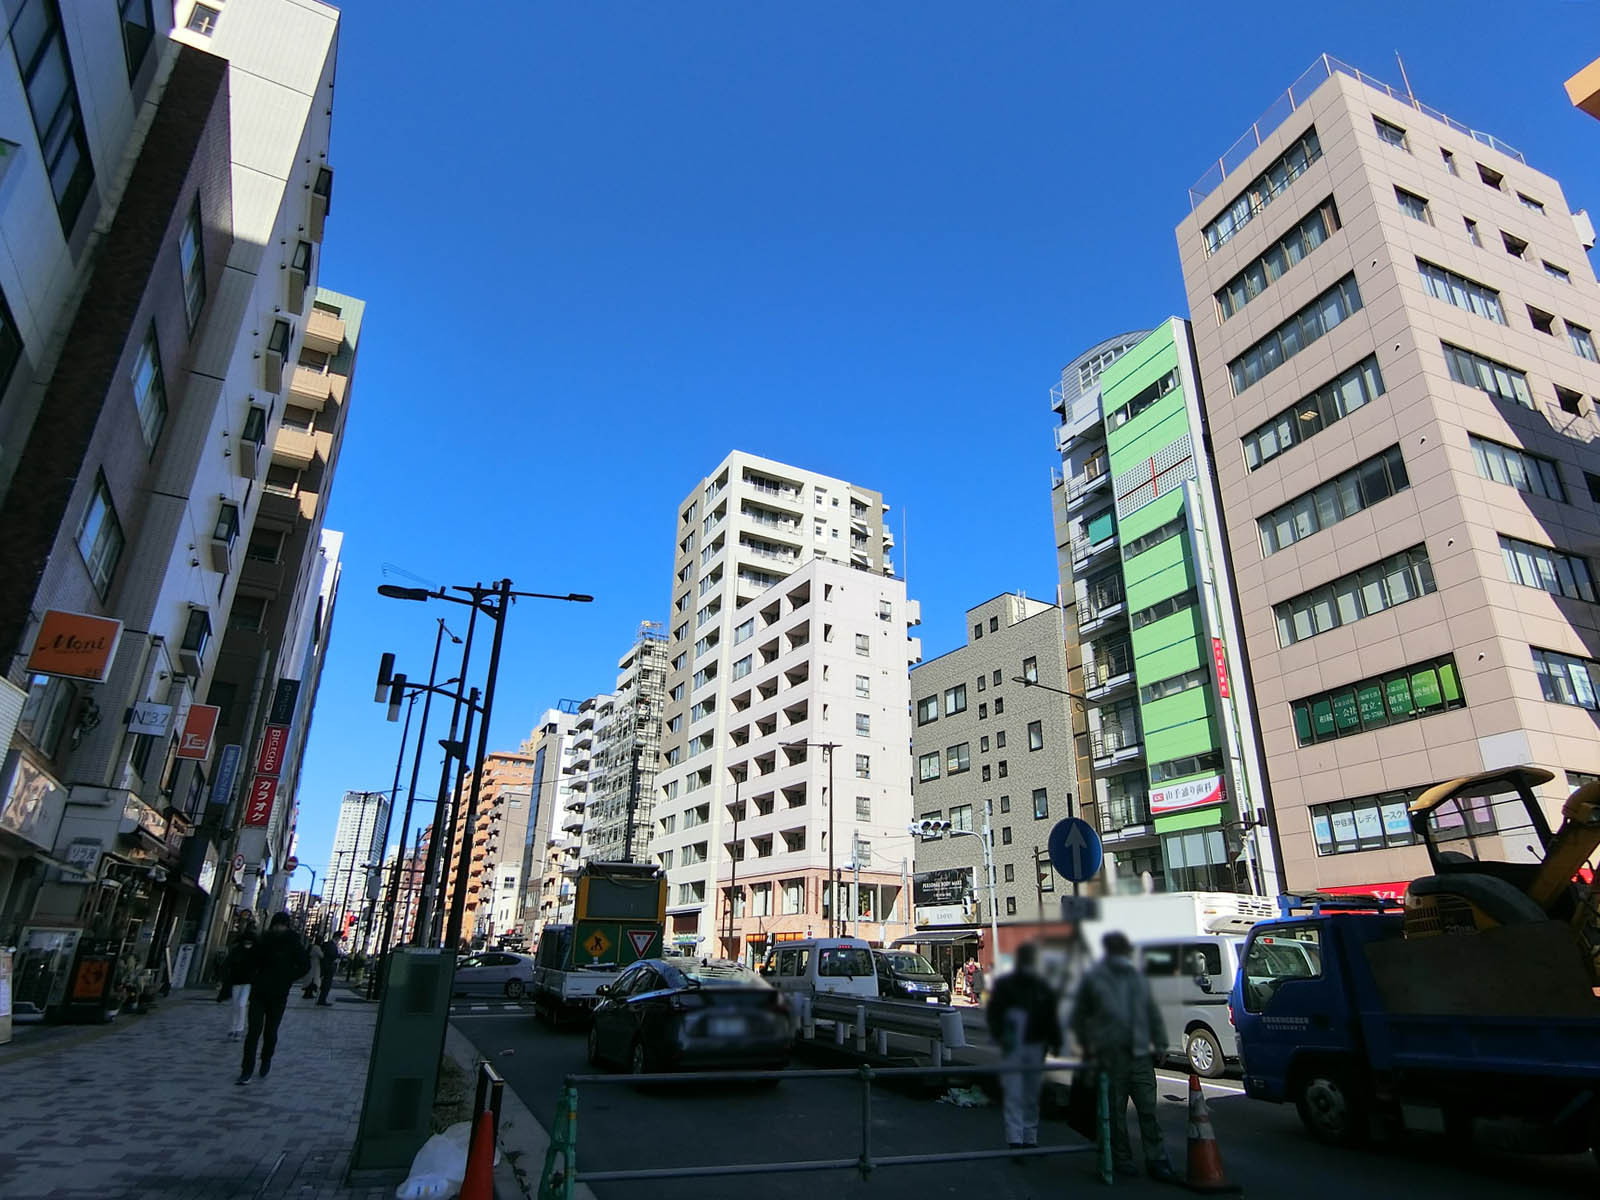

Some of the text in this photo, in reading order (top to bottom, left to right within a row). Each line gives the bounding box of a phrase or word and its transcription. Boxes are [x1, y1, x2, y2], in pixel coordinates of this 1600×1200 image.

[251, 780, 272, 822] カラオケ
[1165, 783, 1212, 800] 山手通り歯科
